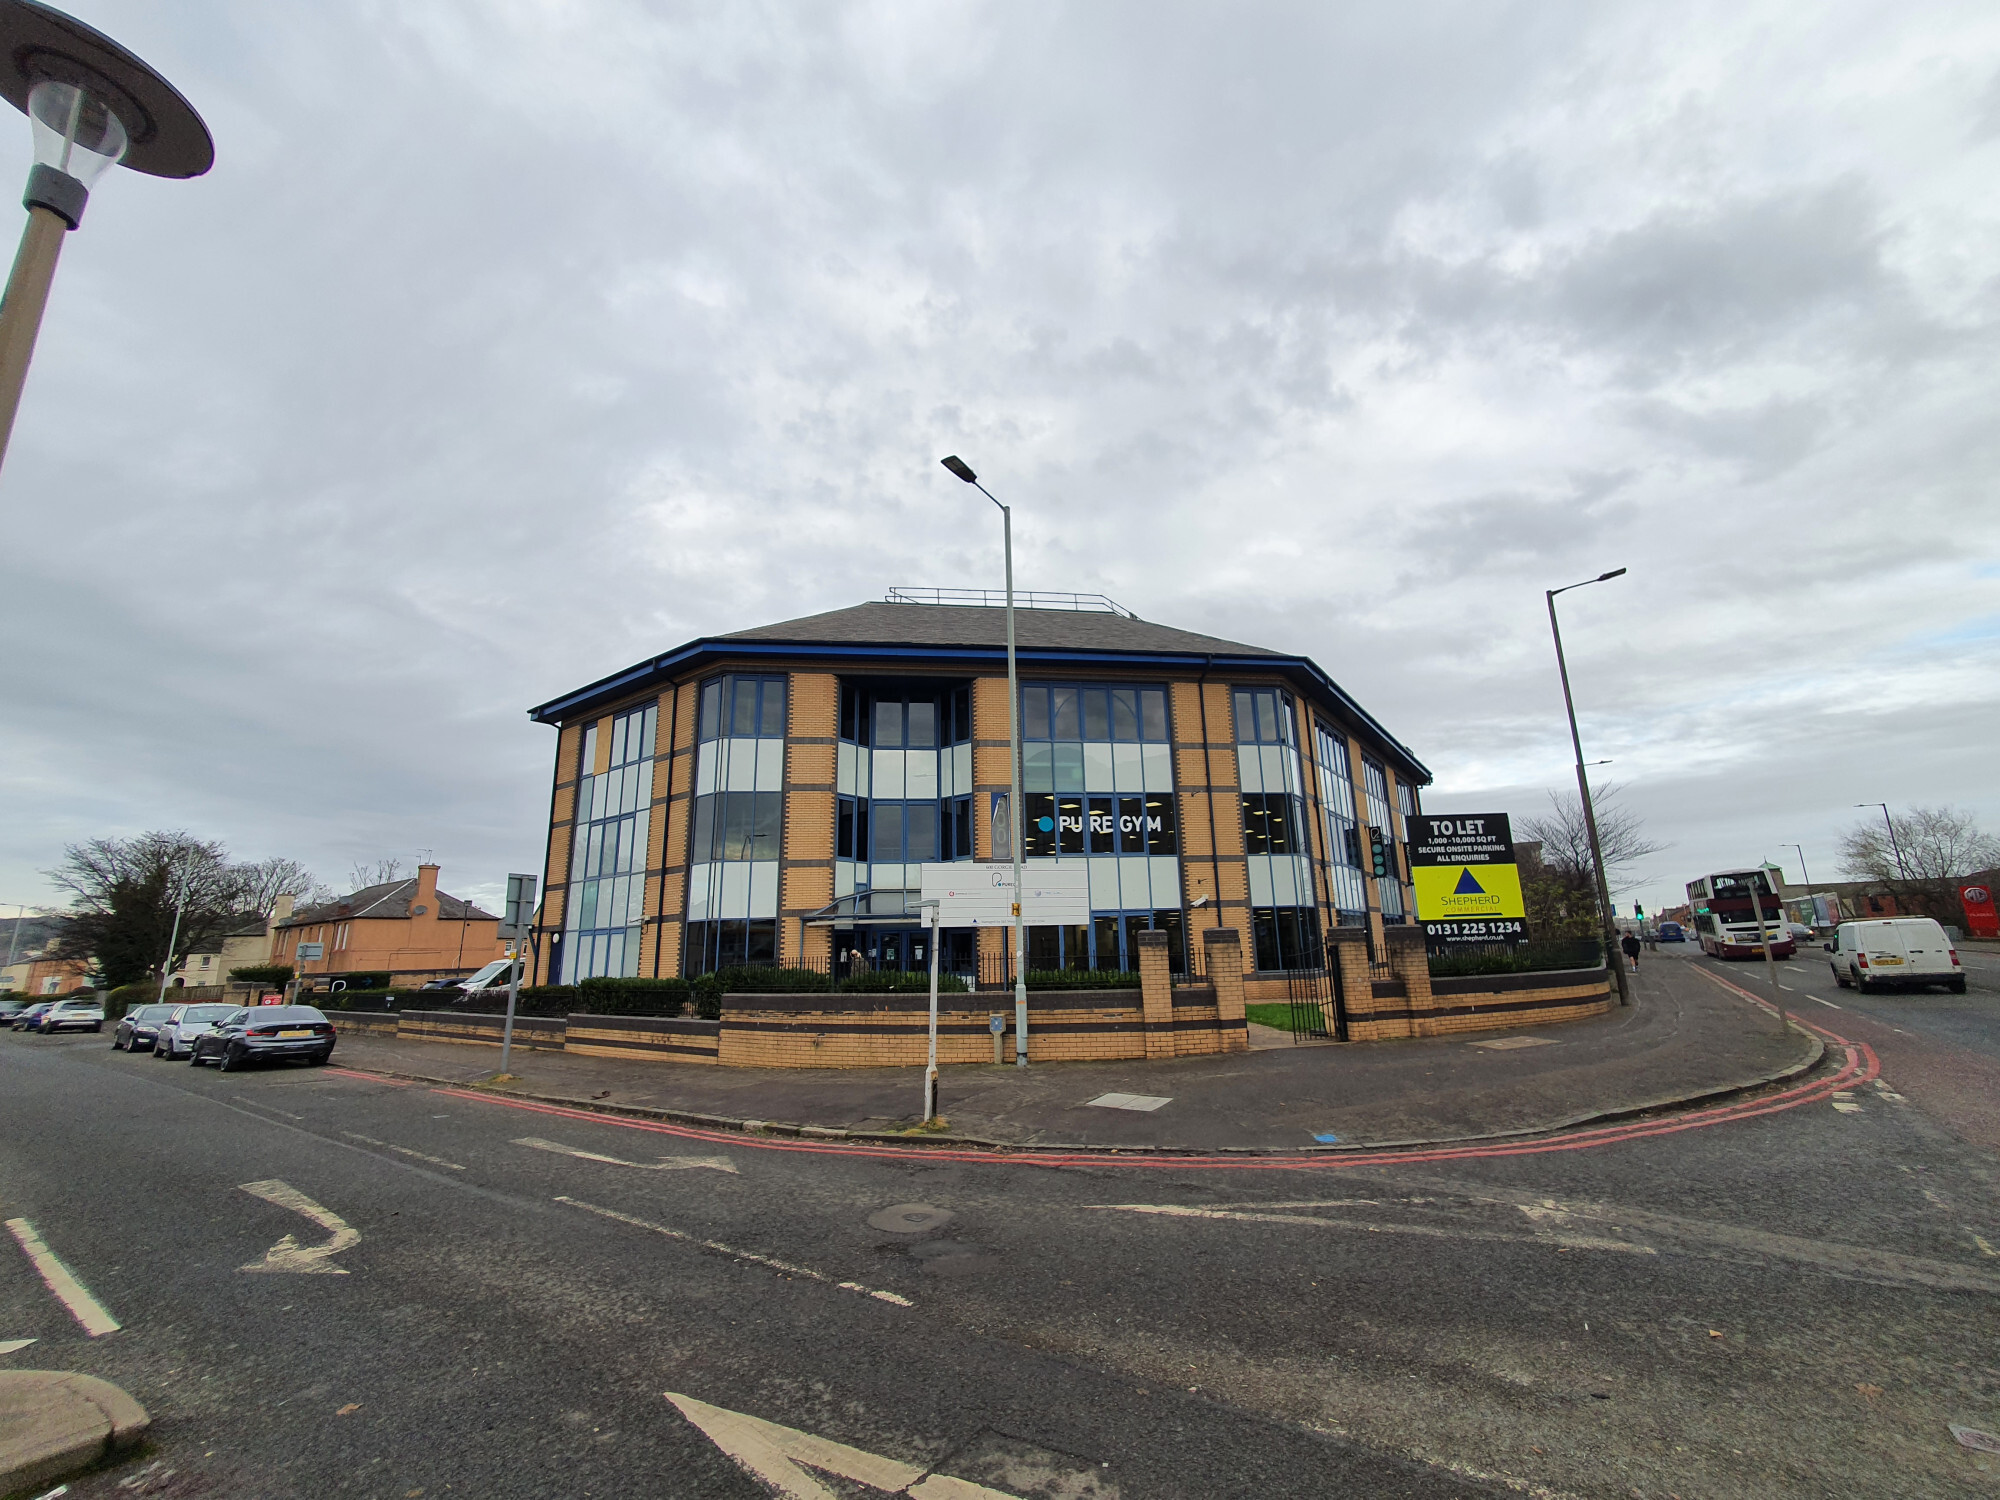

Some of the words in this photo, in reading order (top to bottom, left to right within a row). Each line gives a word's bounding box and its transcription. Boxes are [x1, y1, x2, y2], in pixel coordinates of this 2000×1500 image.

[1430, 820, 1453, 835] TO
[1456, 820, 1484, 835] LET
[1428, 837, 1447, 845] 1,000
[1452, 836, 1475, 844] 10,000
[1487, 835, 1496, 843] FT
[1418, 846, 1445, 854] SECURE
[1446, 845, 1473, 853] ONSITE
[1474, 844, 1506, 852] PARKING
[1451, 853, 1490, 862] ENQUIRIES
[1440, 895, 1500, 906] SHEPHERD
[1427, 923, 1458, 935] 0131
[1461, 922, 1486, 935] 225
[1489, 921, 1521, 934] 1234
